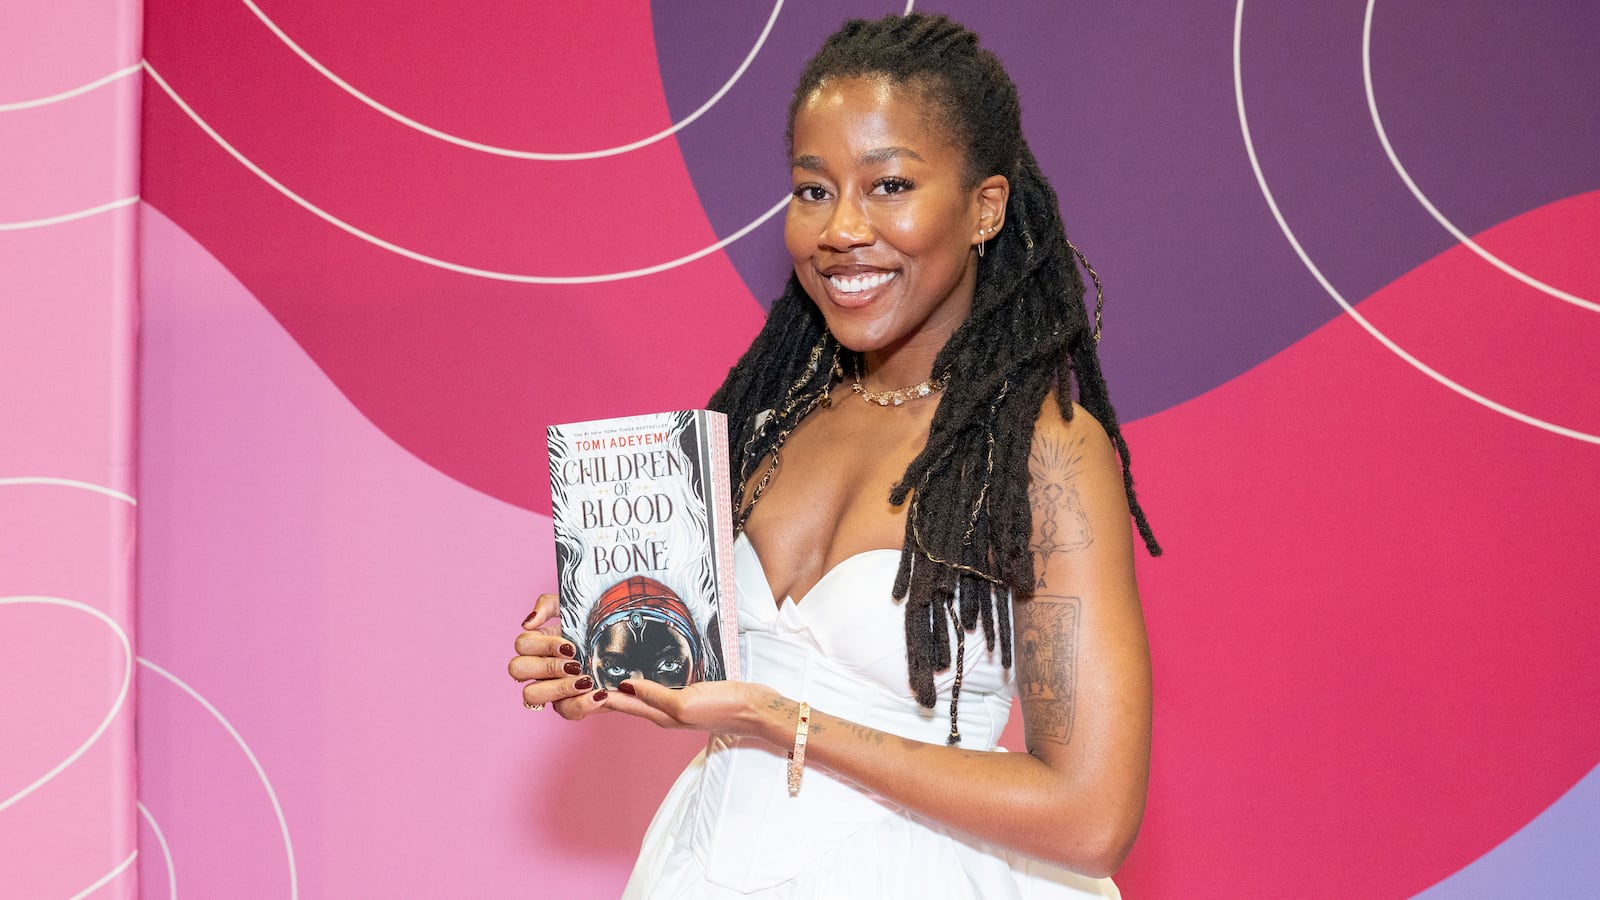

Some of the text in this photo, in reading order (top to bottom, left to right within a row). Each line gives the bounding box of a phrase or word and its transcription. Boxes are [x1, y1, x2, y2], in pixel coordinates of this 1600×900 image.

[575, 431, 669, 452] TOMI ADEYEMI
[562, 449, 684, 487] CHILDREN
[614, 482, 632, 497] OF
[581, 493, 674, 530] BLOOD
[615, 527, 640, 543] AND
[593, 537, 669, 575] BONE
